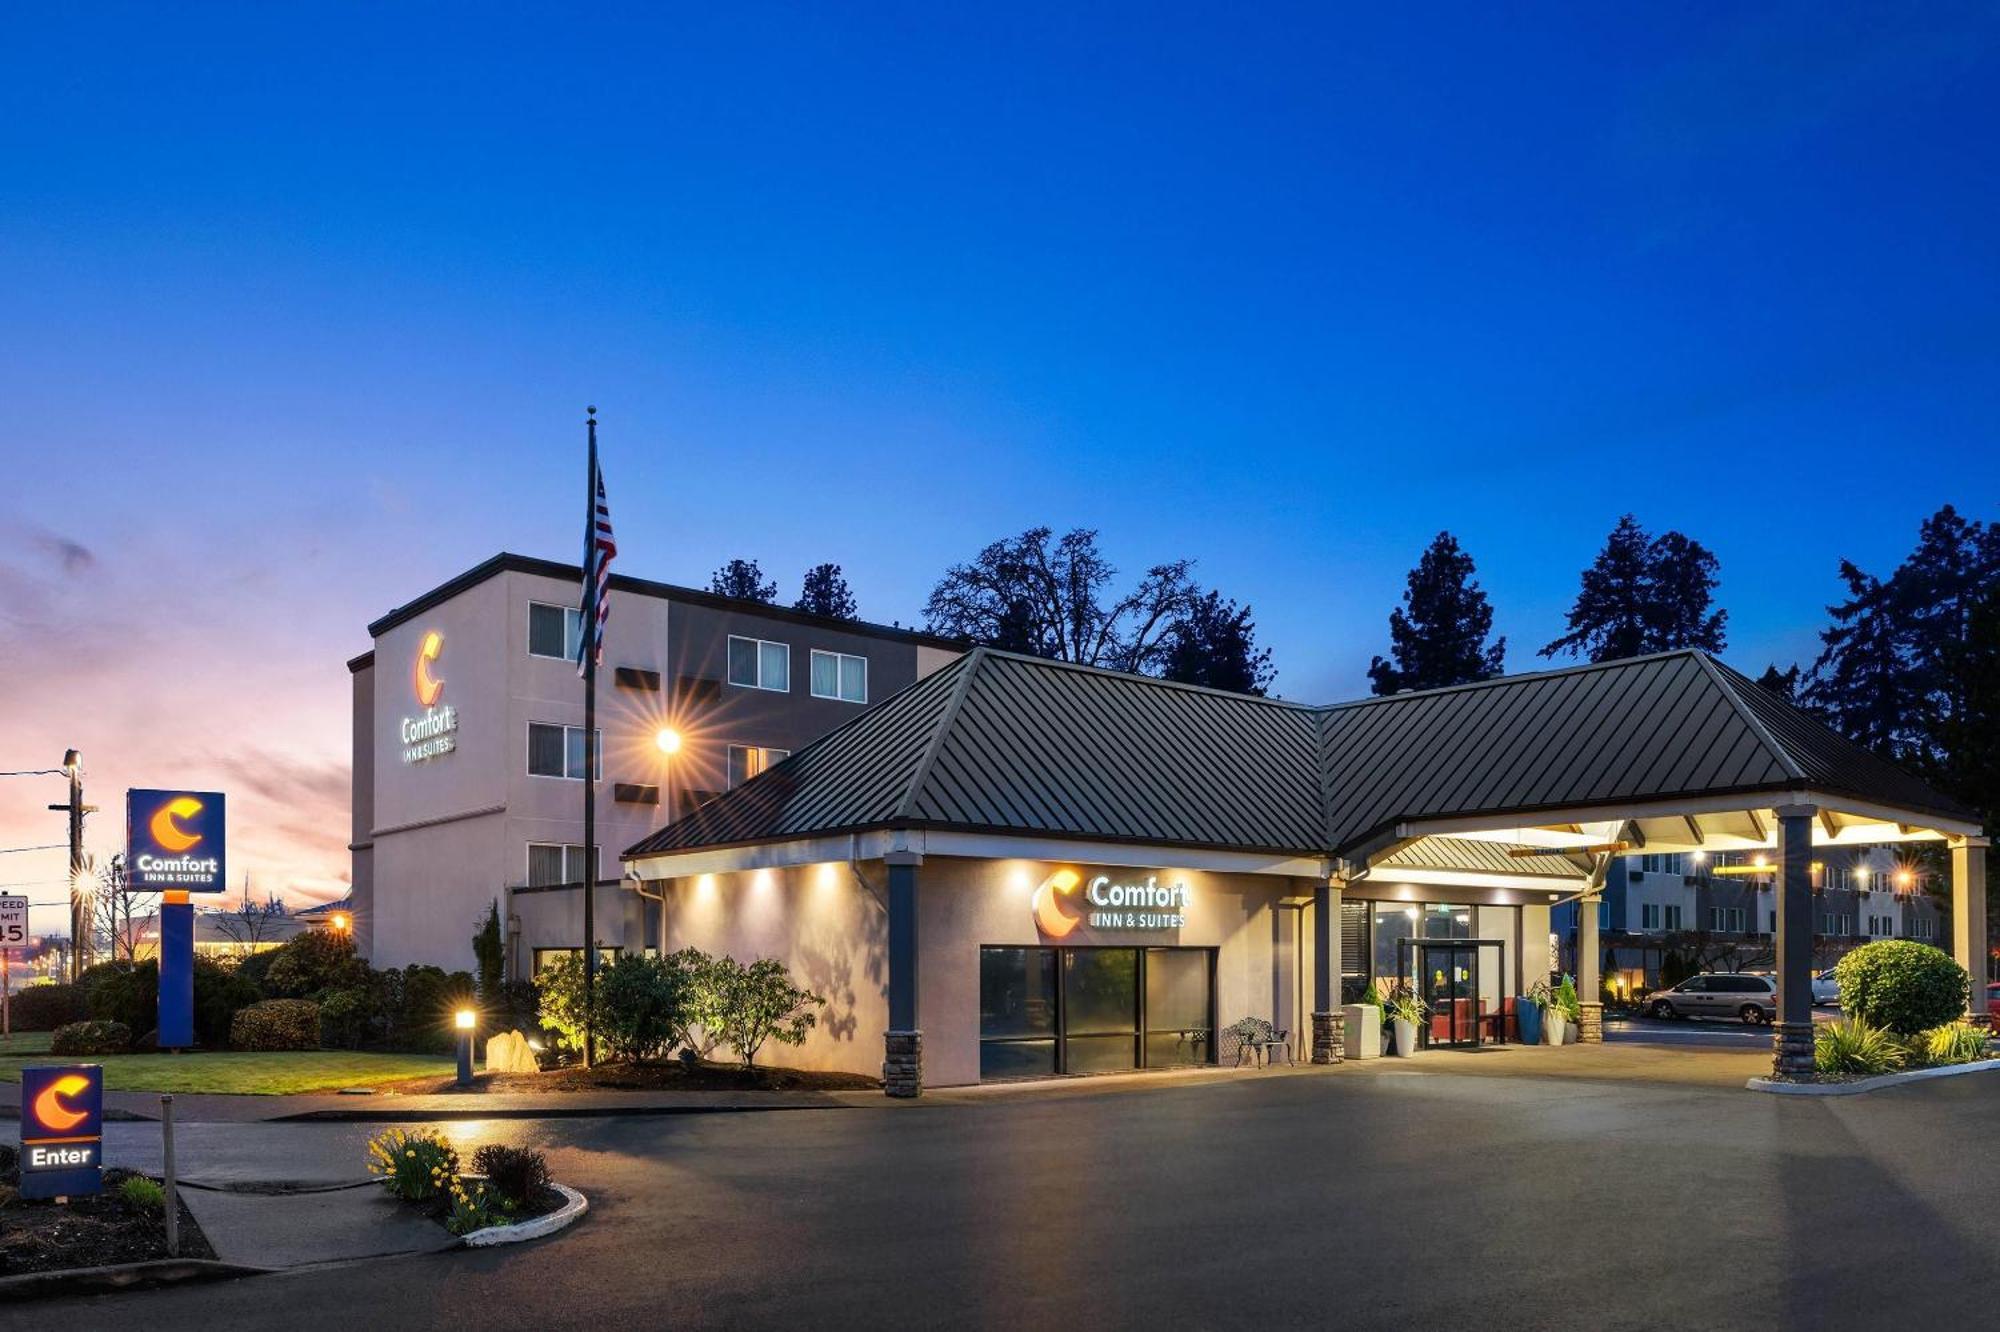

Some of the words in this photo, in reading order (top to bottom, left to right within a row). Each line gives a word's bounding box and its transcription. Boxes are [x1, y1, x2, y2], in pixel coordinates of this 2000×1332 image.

[402, 706, 453, 744] Comfort
[423, 739, 449, 756] SUITES
[138, 855, 217, 873] Comfort
[144, 873, 165, 881] INN
[167, 873, 174, 881] &
[176, 874, 213, 882] SUITES
[1091, 875, 1191, 907] Comfort
[1, 913, 19, 921] MIT
[1094, 913, 1122, 928] INN
[1126, 913, 1135, 927] &
[1139, 914, 1185, 928] SUITES
[32, 1149, 91, 1166] Enter
